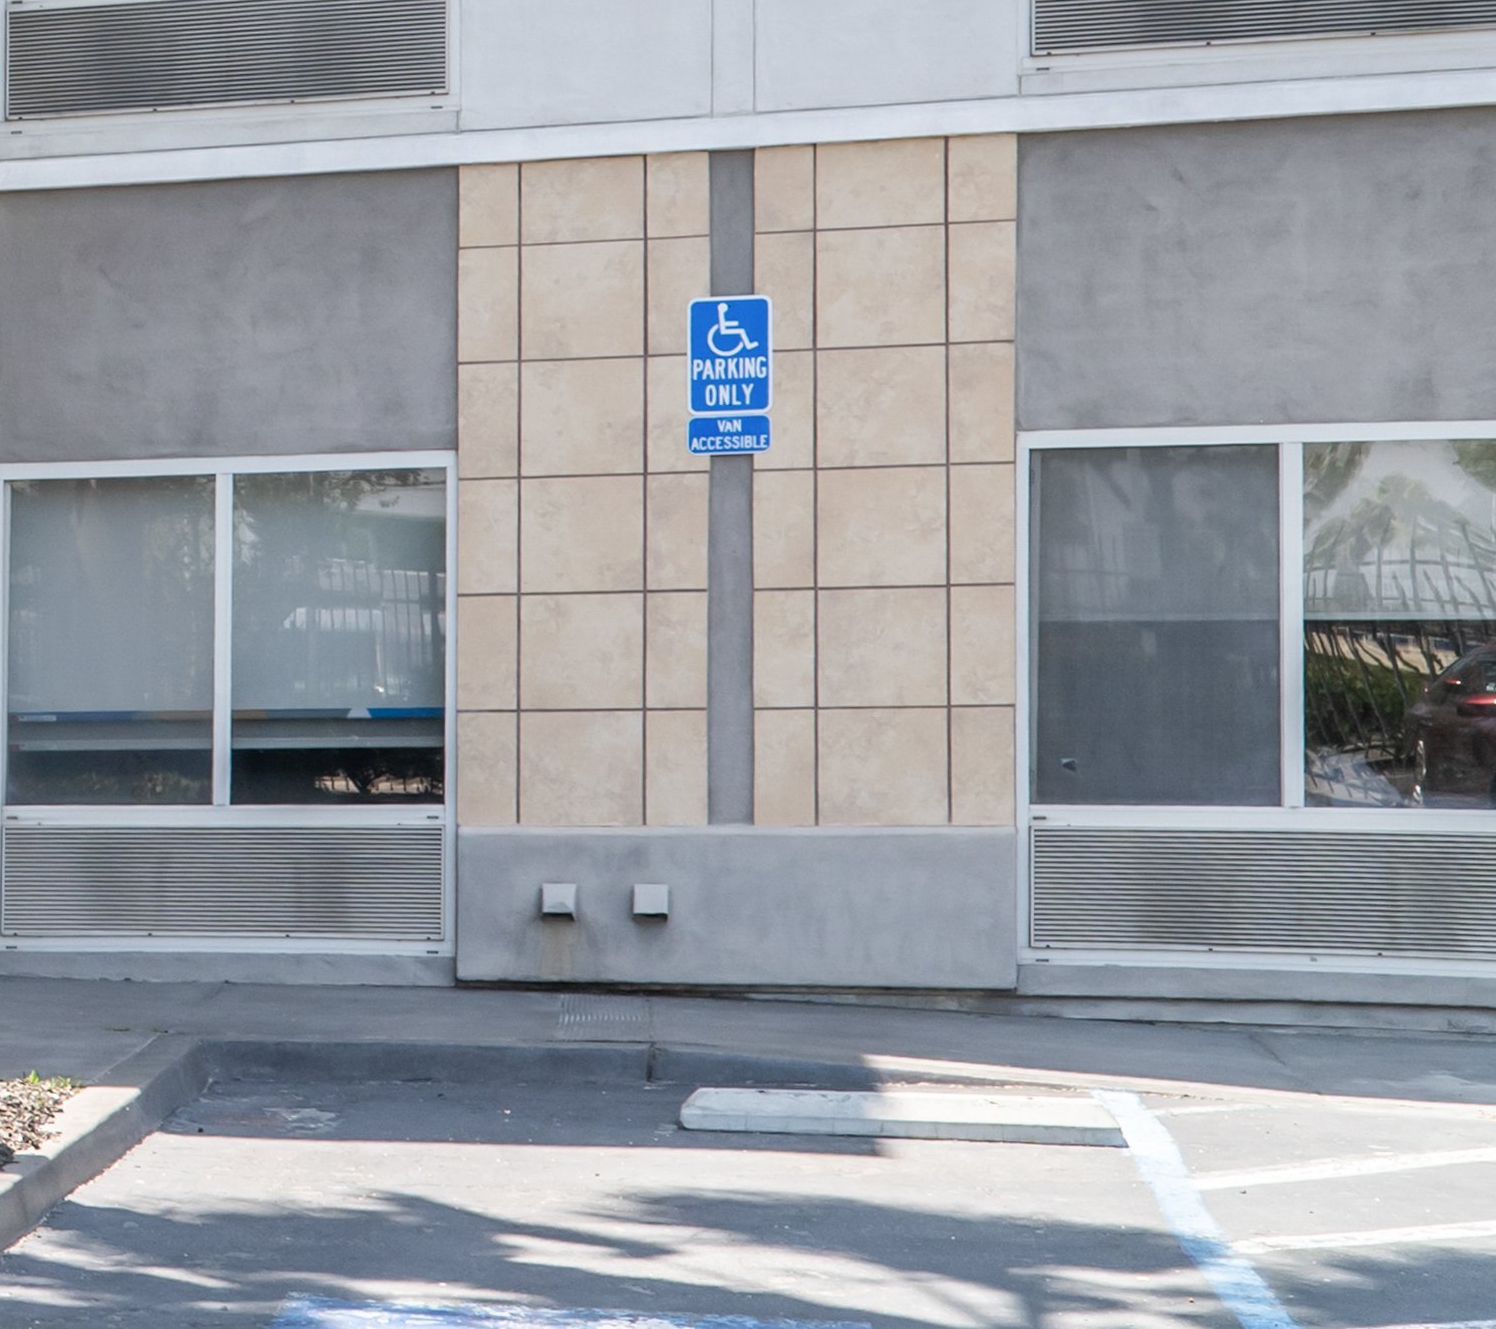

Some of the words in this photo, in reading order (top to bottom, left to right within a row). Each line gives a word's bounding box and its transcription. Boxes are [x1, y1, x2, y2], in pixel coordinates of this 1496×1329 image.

[692, 356, 768, 381] PARKING
[704, 383, 754, 406] ONLY
[717, 419, 742, 433] VAN
[690, 434, 768, 451] ACCESSIBLE
